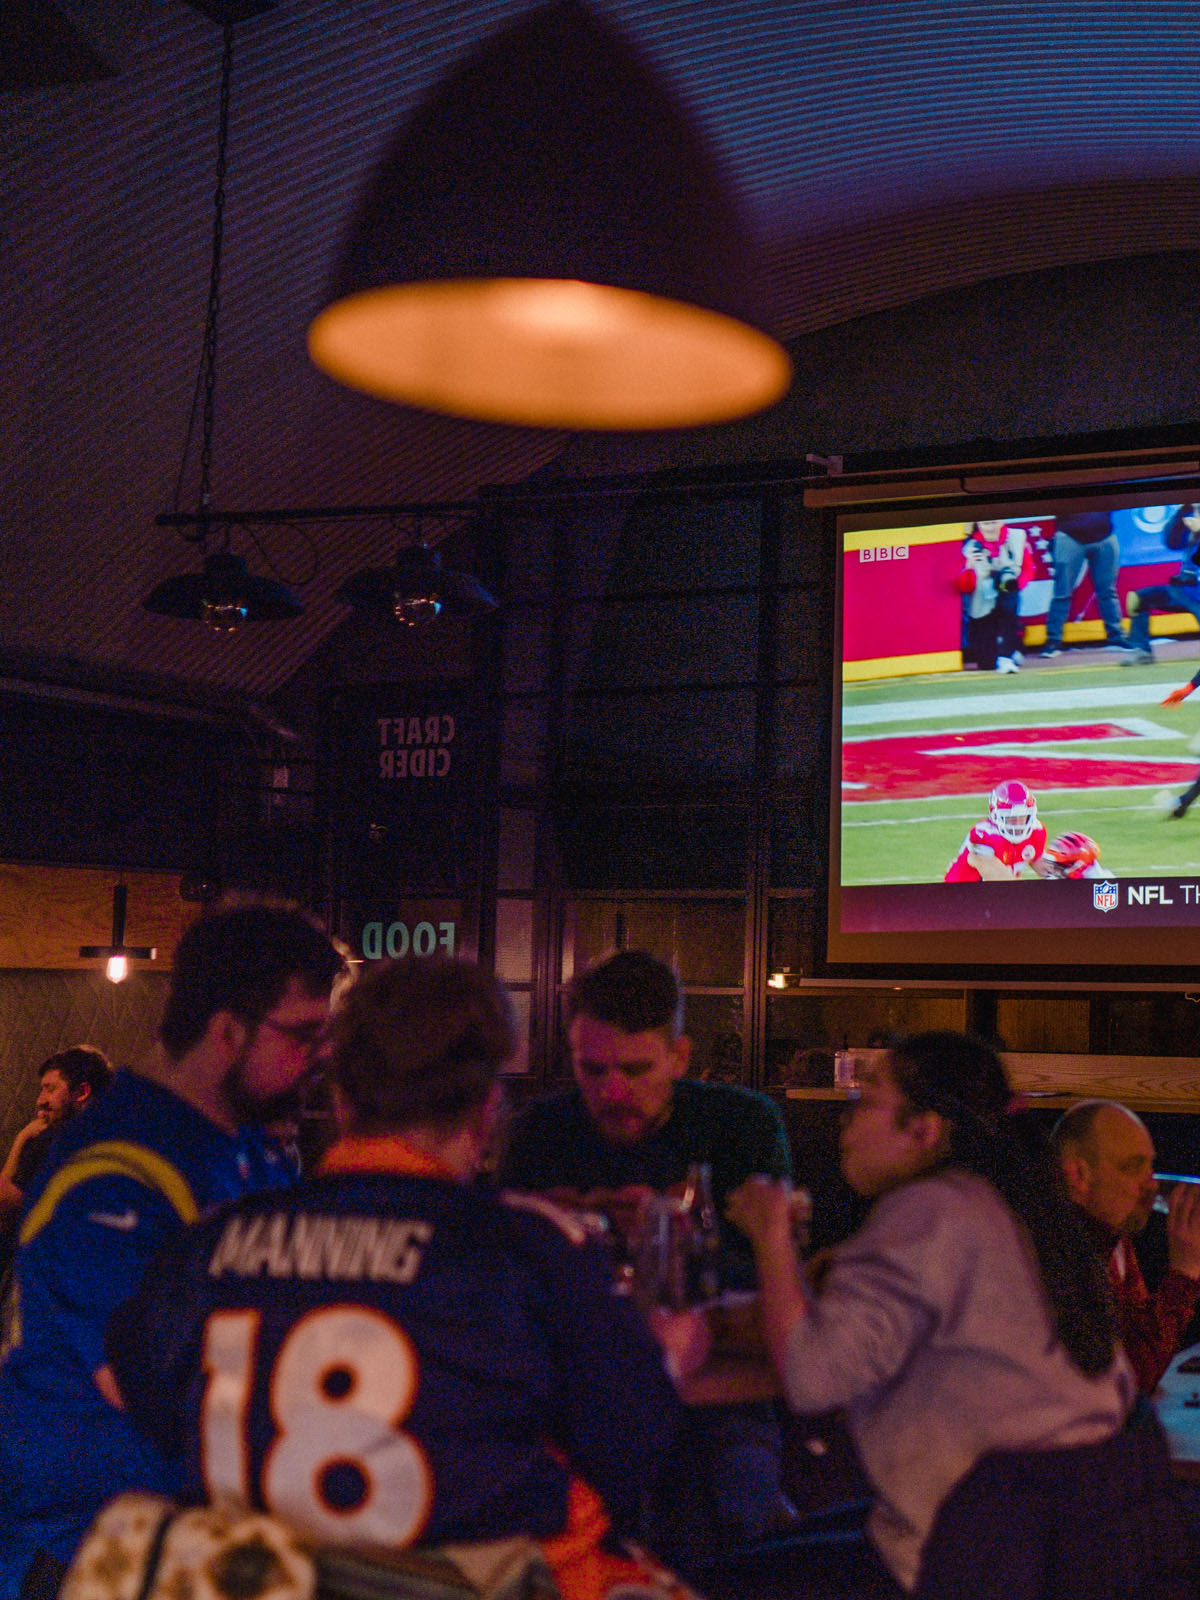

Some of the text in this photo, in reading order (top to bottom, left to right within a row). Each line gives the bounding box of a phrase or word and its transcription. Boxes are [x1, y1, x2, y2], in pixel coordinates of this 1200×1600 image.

[862, 545, 907, 561] BBC
[1097, 894, 1115, 907] NFL
[1127, 885, 1173, 905] NFL
[208, 1212, 434, 1285] MANNING
[202, 1302, 435, 1550] 18
